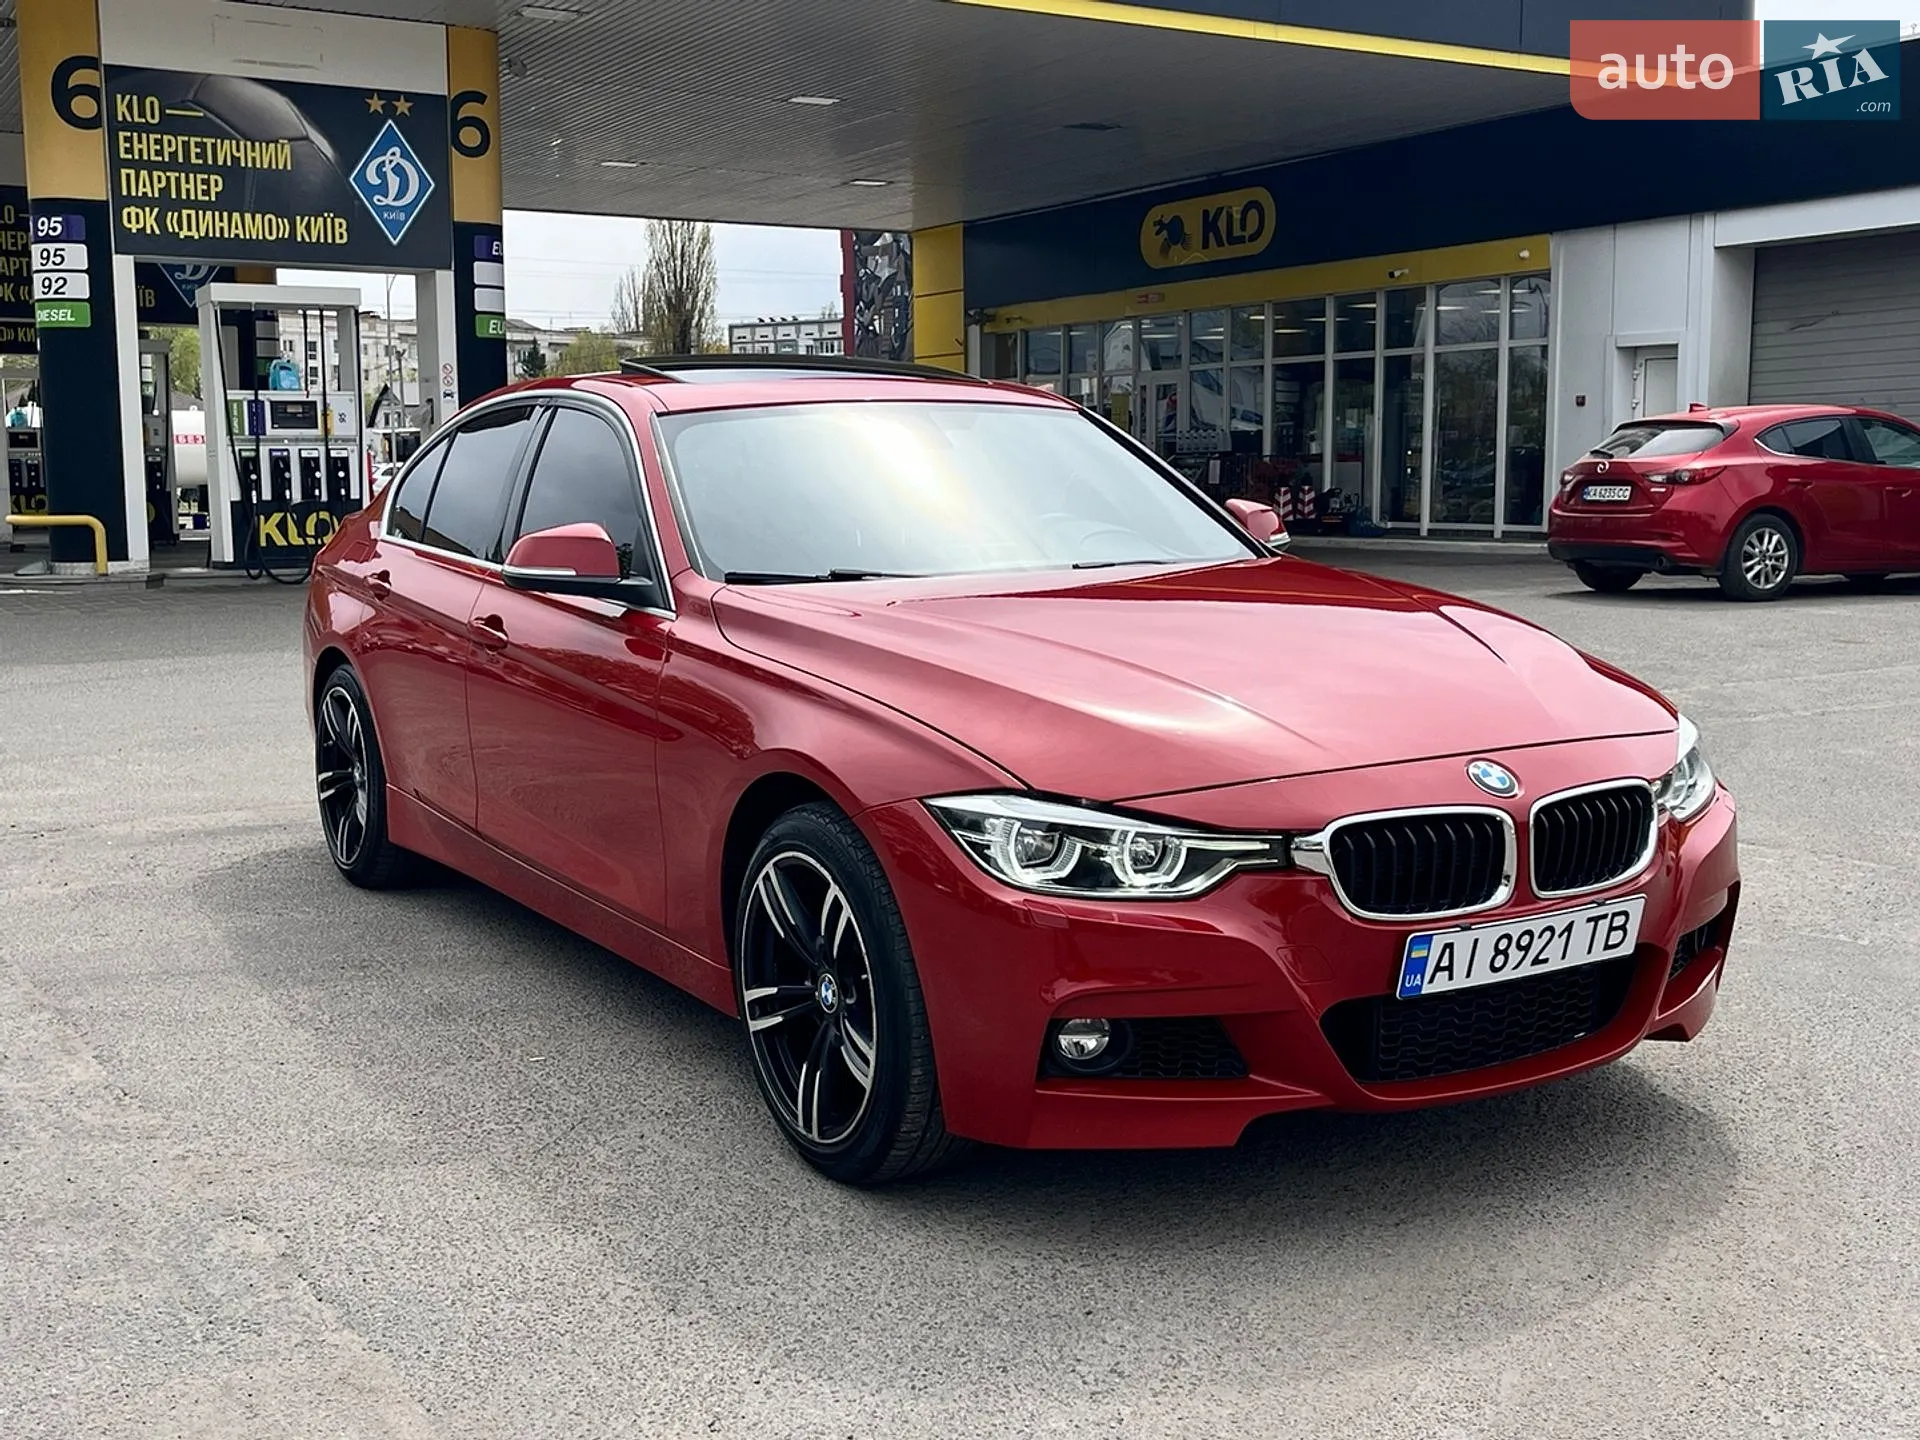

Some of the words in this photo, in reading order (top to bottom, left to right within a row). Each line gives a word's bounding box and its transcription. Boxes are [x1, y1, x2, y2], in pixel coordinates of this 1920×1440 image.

[51, 55, 102, 129] 6
[116, 94, 160, 124] KLO
[451, 90, 491, 158] 6
[118, 131, 293, 171] ЕНЕРГЕТИЧНИЙ
[120, 168, 223, 201] ПАРТНЕР
[37, 217, 63, 236] 95
[122, 206, 160, 235] ФК
[166, 209, 289, 240] «ДИНАМО»
[296, 212, 348, 244] КИЇВ
[1202, 200, 1265, 249] KLO
[40, 248, 65, 267] 95
[41, 277, 68, 296] 92
[1427, 938, 1479, 984] AI
[1489, 920, 1575, 974] 8921
[1586, 909, 1631, 956] TB
[1404, 974, 1422, 988] UA
